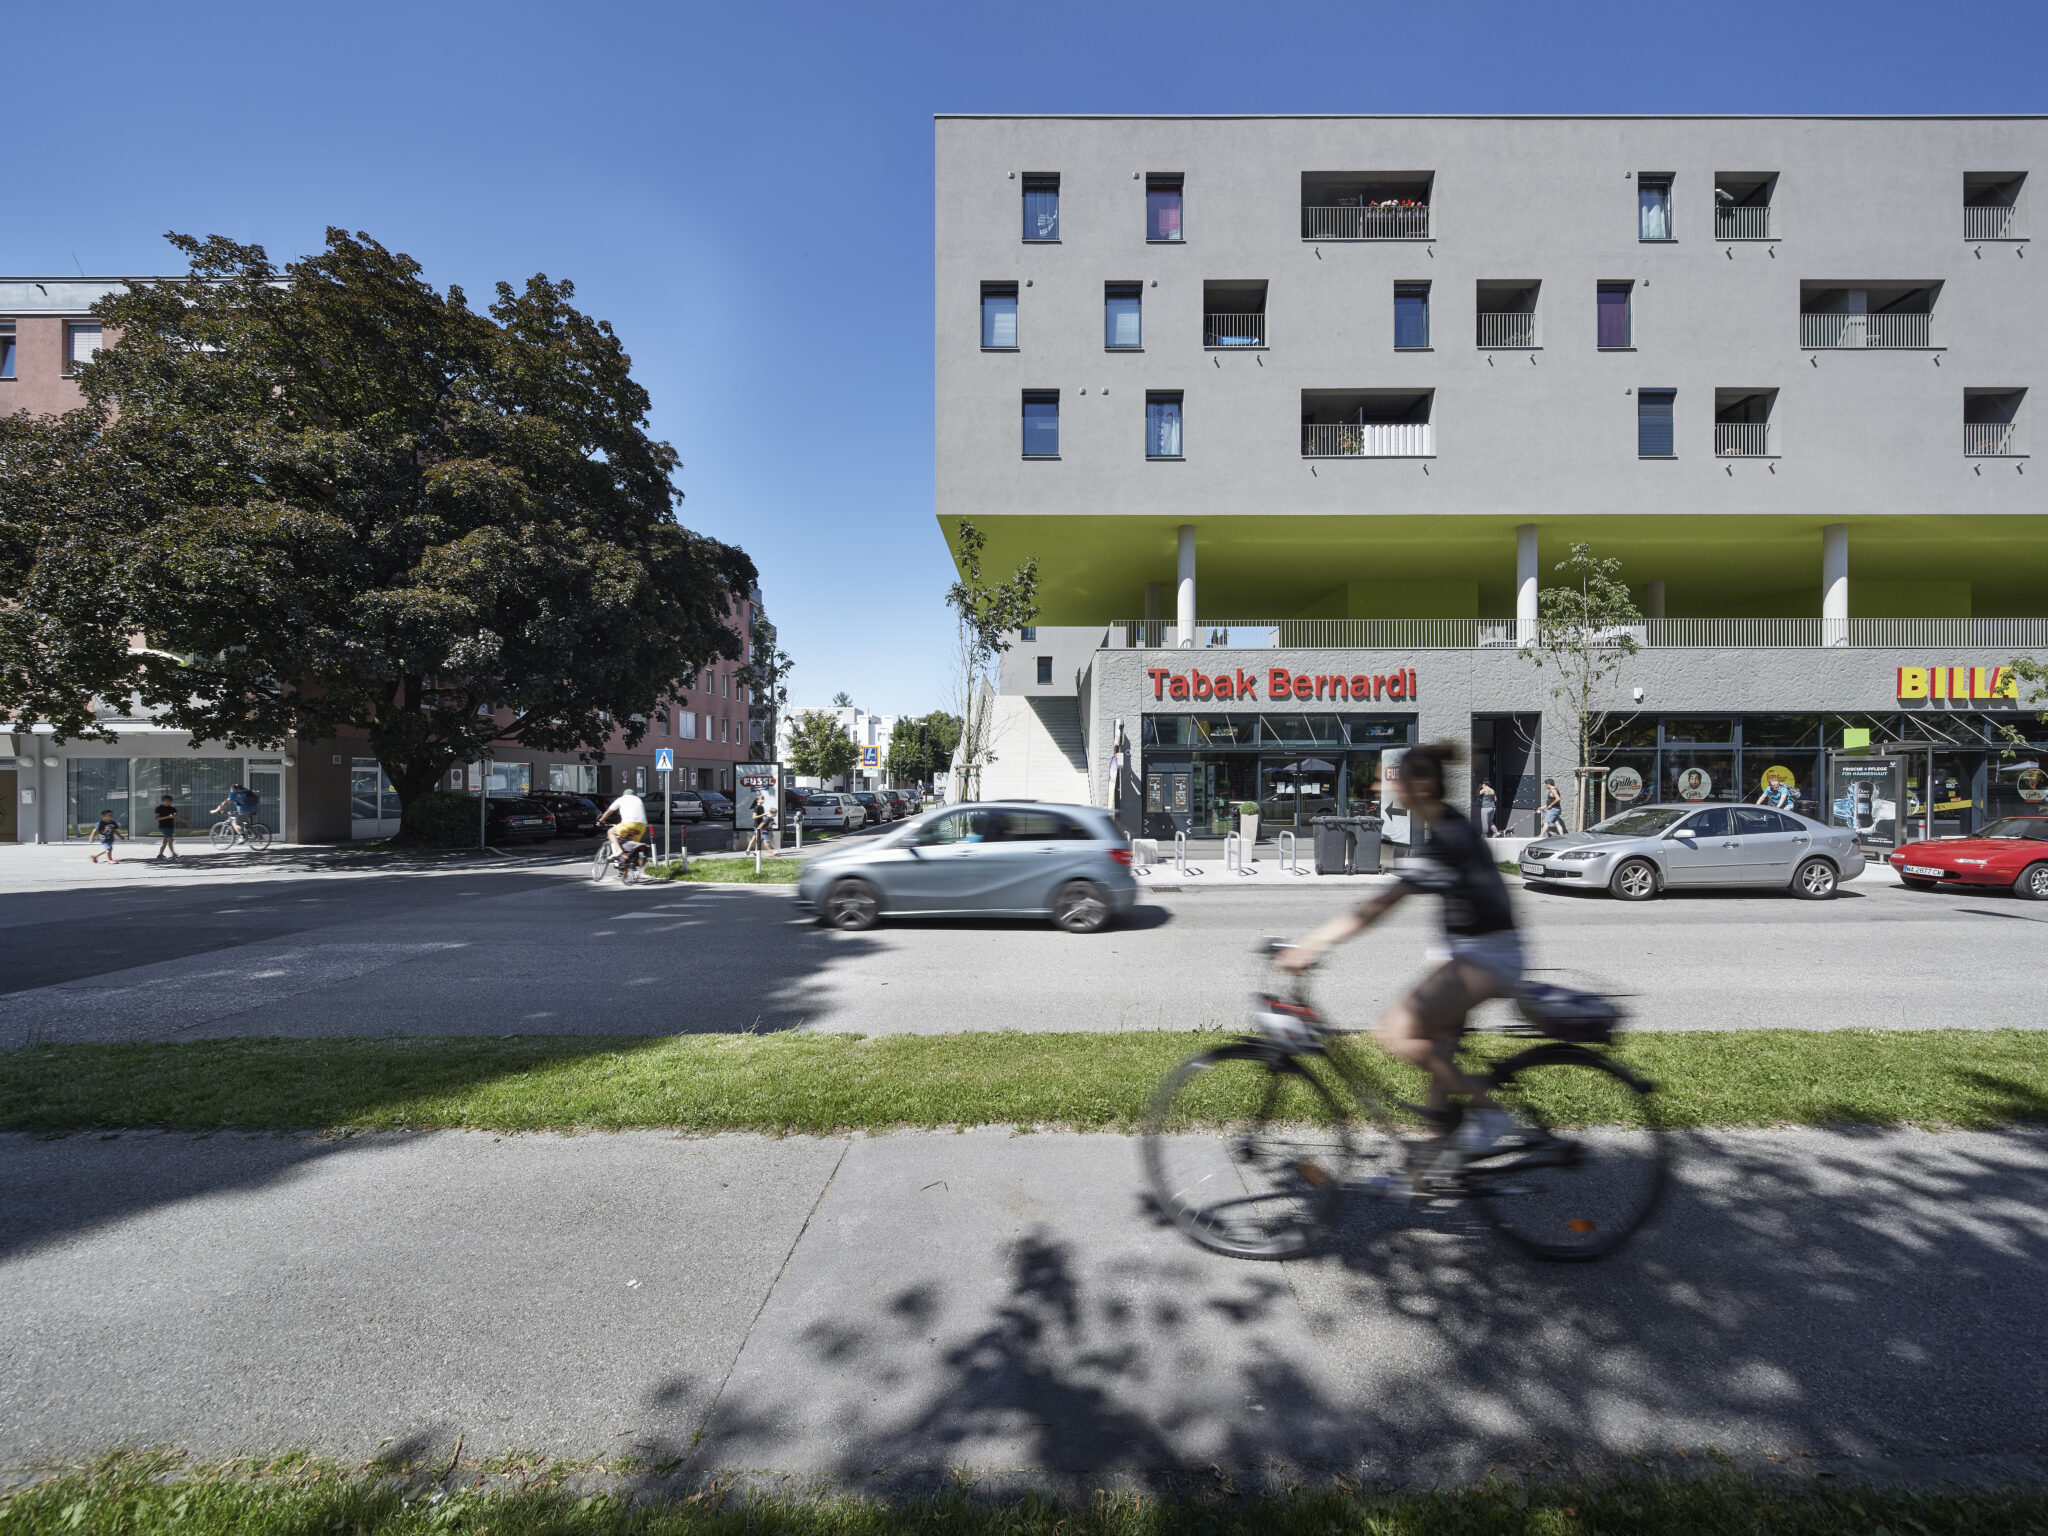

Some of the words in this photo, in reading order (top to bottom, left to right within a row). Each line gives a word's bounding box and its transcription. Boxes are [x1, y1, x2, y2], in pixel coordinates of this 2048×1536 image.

[1147, 668, 1256, 698] Tabak
[1268, 667, 1416, 698] Bernardi
[1897, 666, 2019, 699] BILLA
[743, 777, 774, 786] FUSSL
